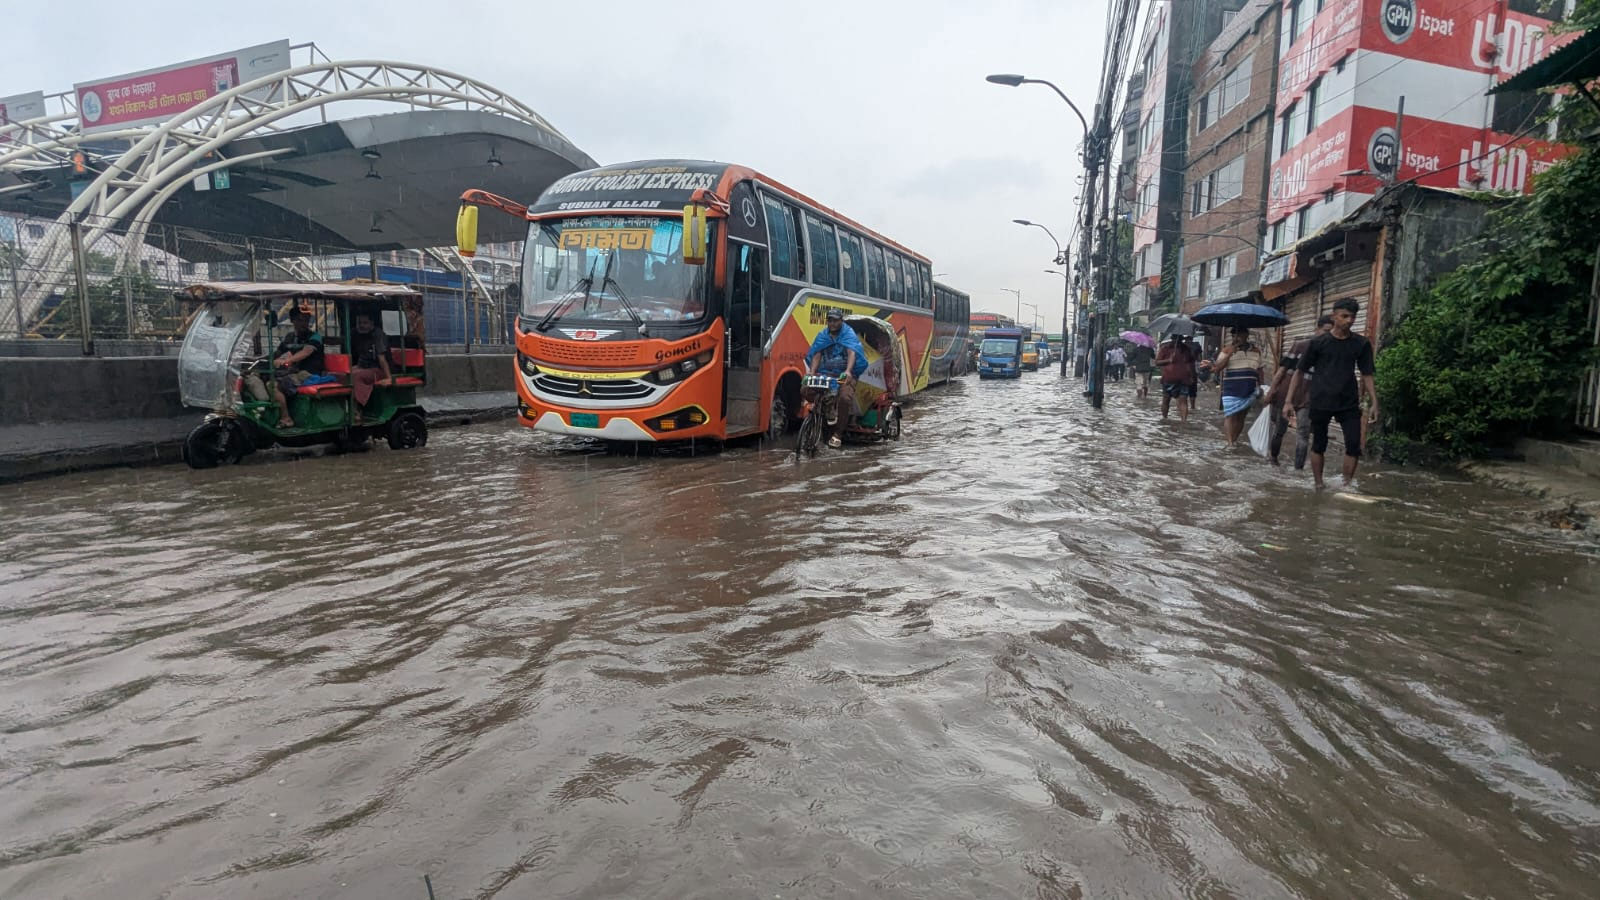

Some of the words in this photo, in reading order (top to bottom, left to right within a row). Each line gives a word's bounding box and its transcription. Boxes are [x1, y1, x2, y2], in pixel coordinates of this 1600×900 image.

[1386, 4, 1411, 27] GPH
[1419, 8, 1455, 37] ispat
[1405, 147, 1440, 173] ispat
[595, 174, 651, 191] GOLDEN
[644, 172, 719, 191] EXPRESS
[558, 201, 611, 210] SUBHAN
[612, 200, 662, 209] ALLAH
